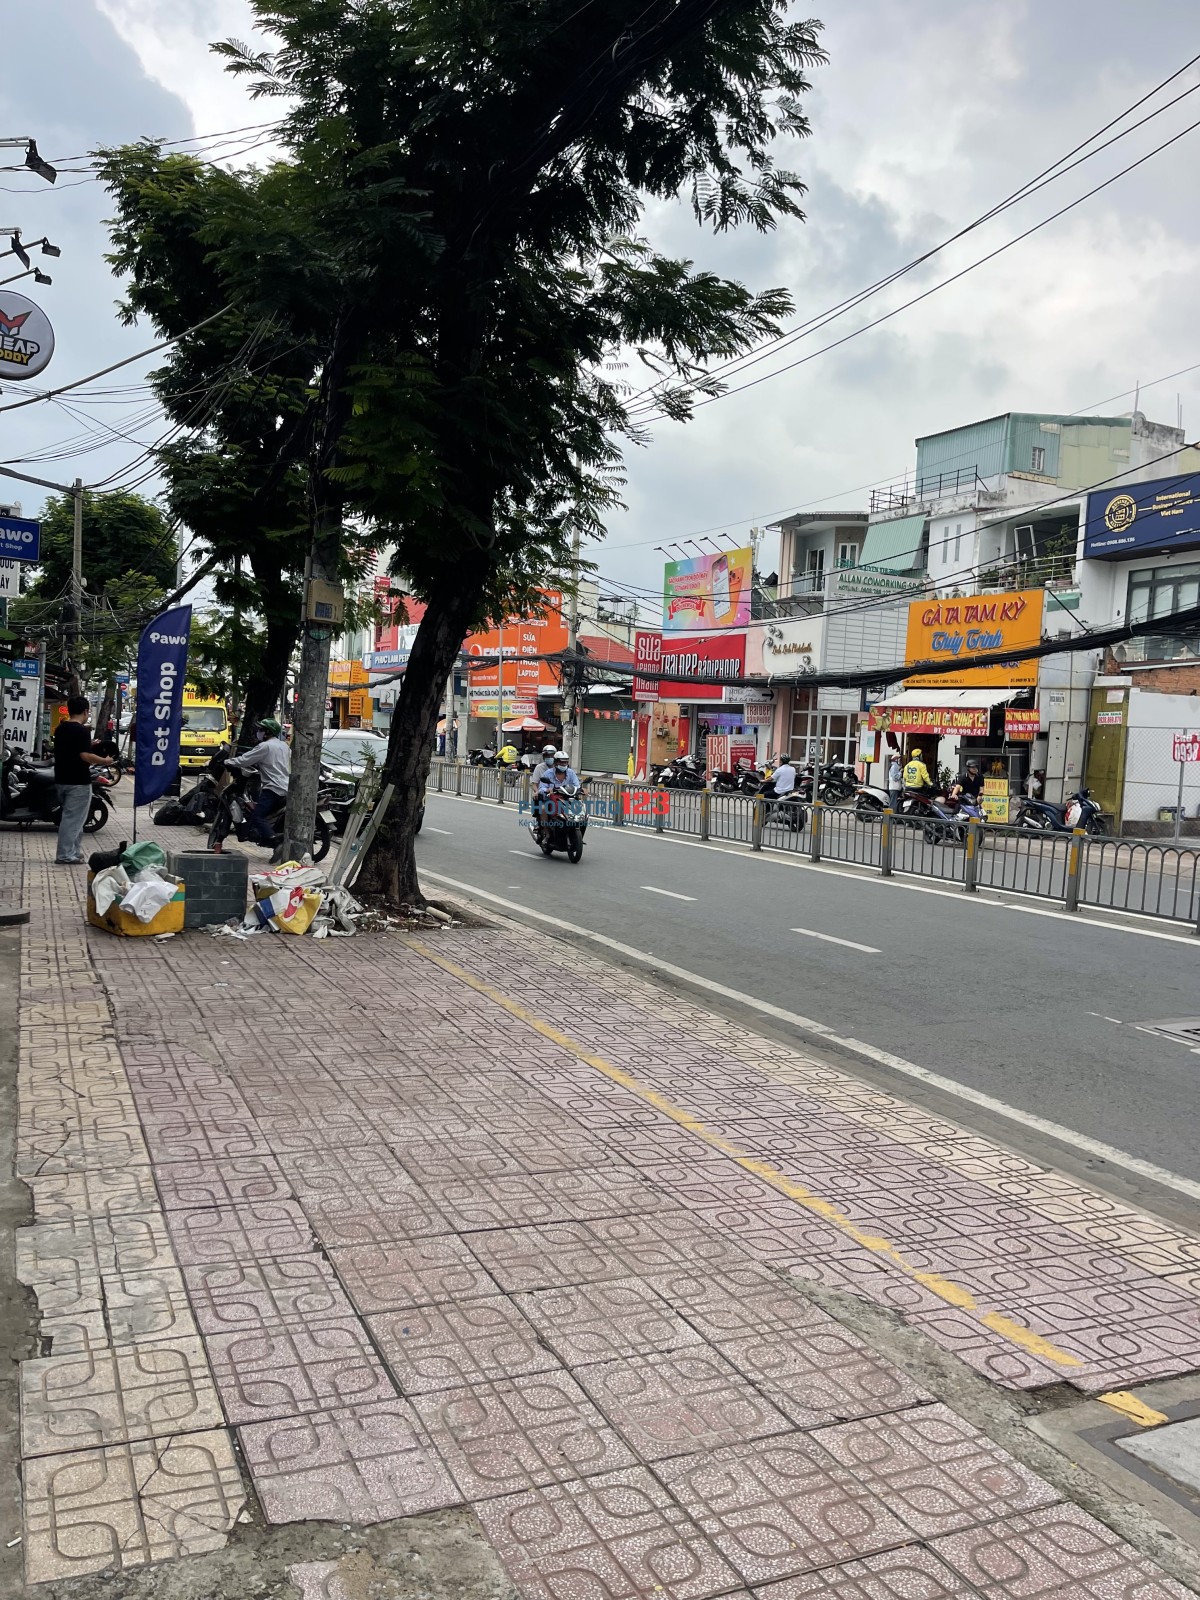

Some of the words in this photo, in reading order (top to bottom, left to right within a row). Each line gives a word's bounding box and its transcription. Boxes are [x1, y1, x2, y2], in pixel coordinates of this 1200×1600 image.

[5, 543, 23, 551] Shop
[838, 573, 861, 585] ALLAN
[921, 603, 943, 627] GÀ
[944, 606, 961, 626] TA
[963, 602, 998, 624] TAM
[1000, 596, 1028, 621] KỲ
[149, 631, 188, 646] Pawo
[518, 669, 539, 679] LAPTOP
[154, 662, 178, 720] Shop
[11, 707, 32, 722] TÂY
[151, 727, 171, 767] Pet
[906, 764, 918, 775] be
